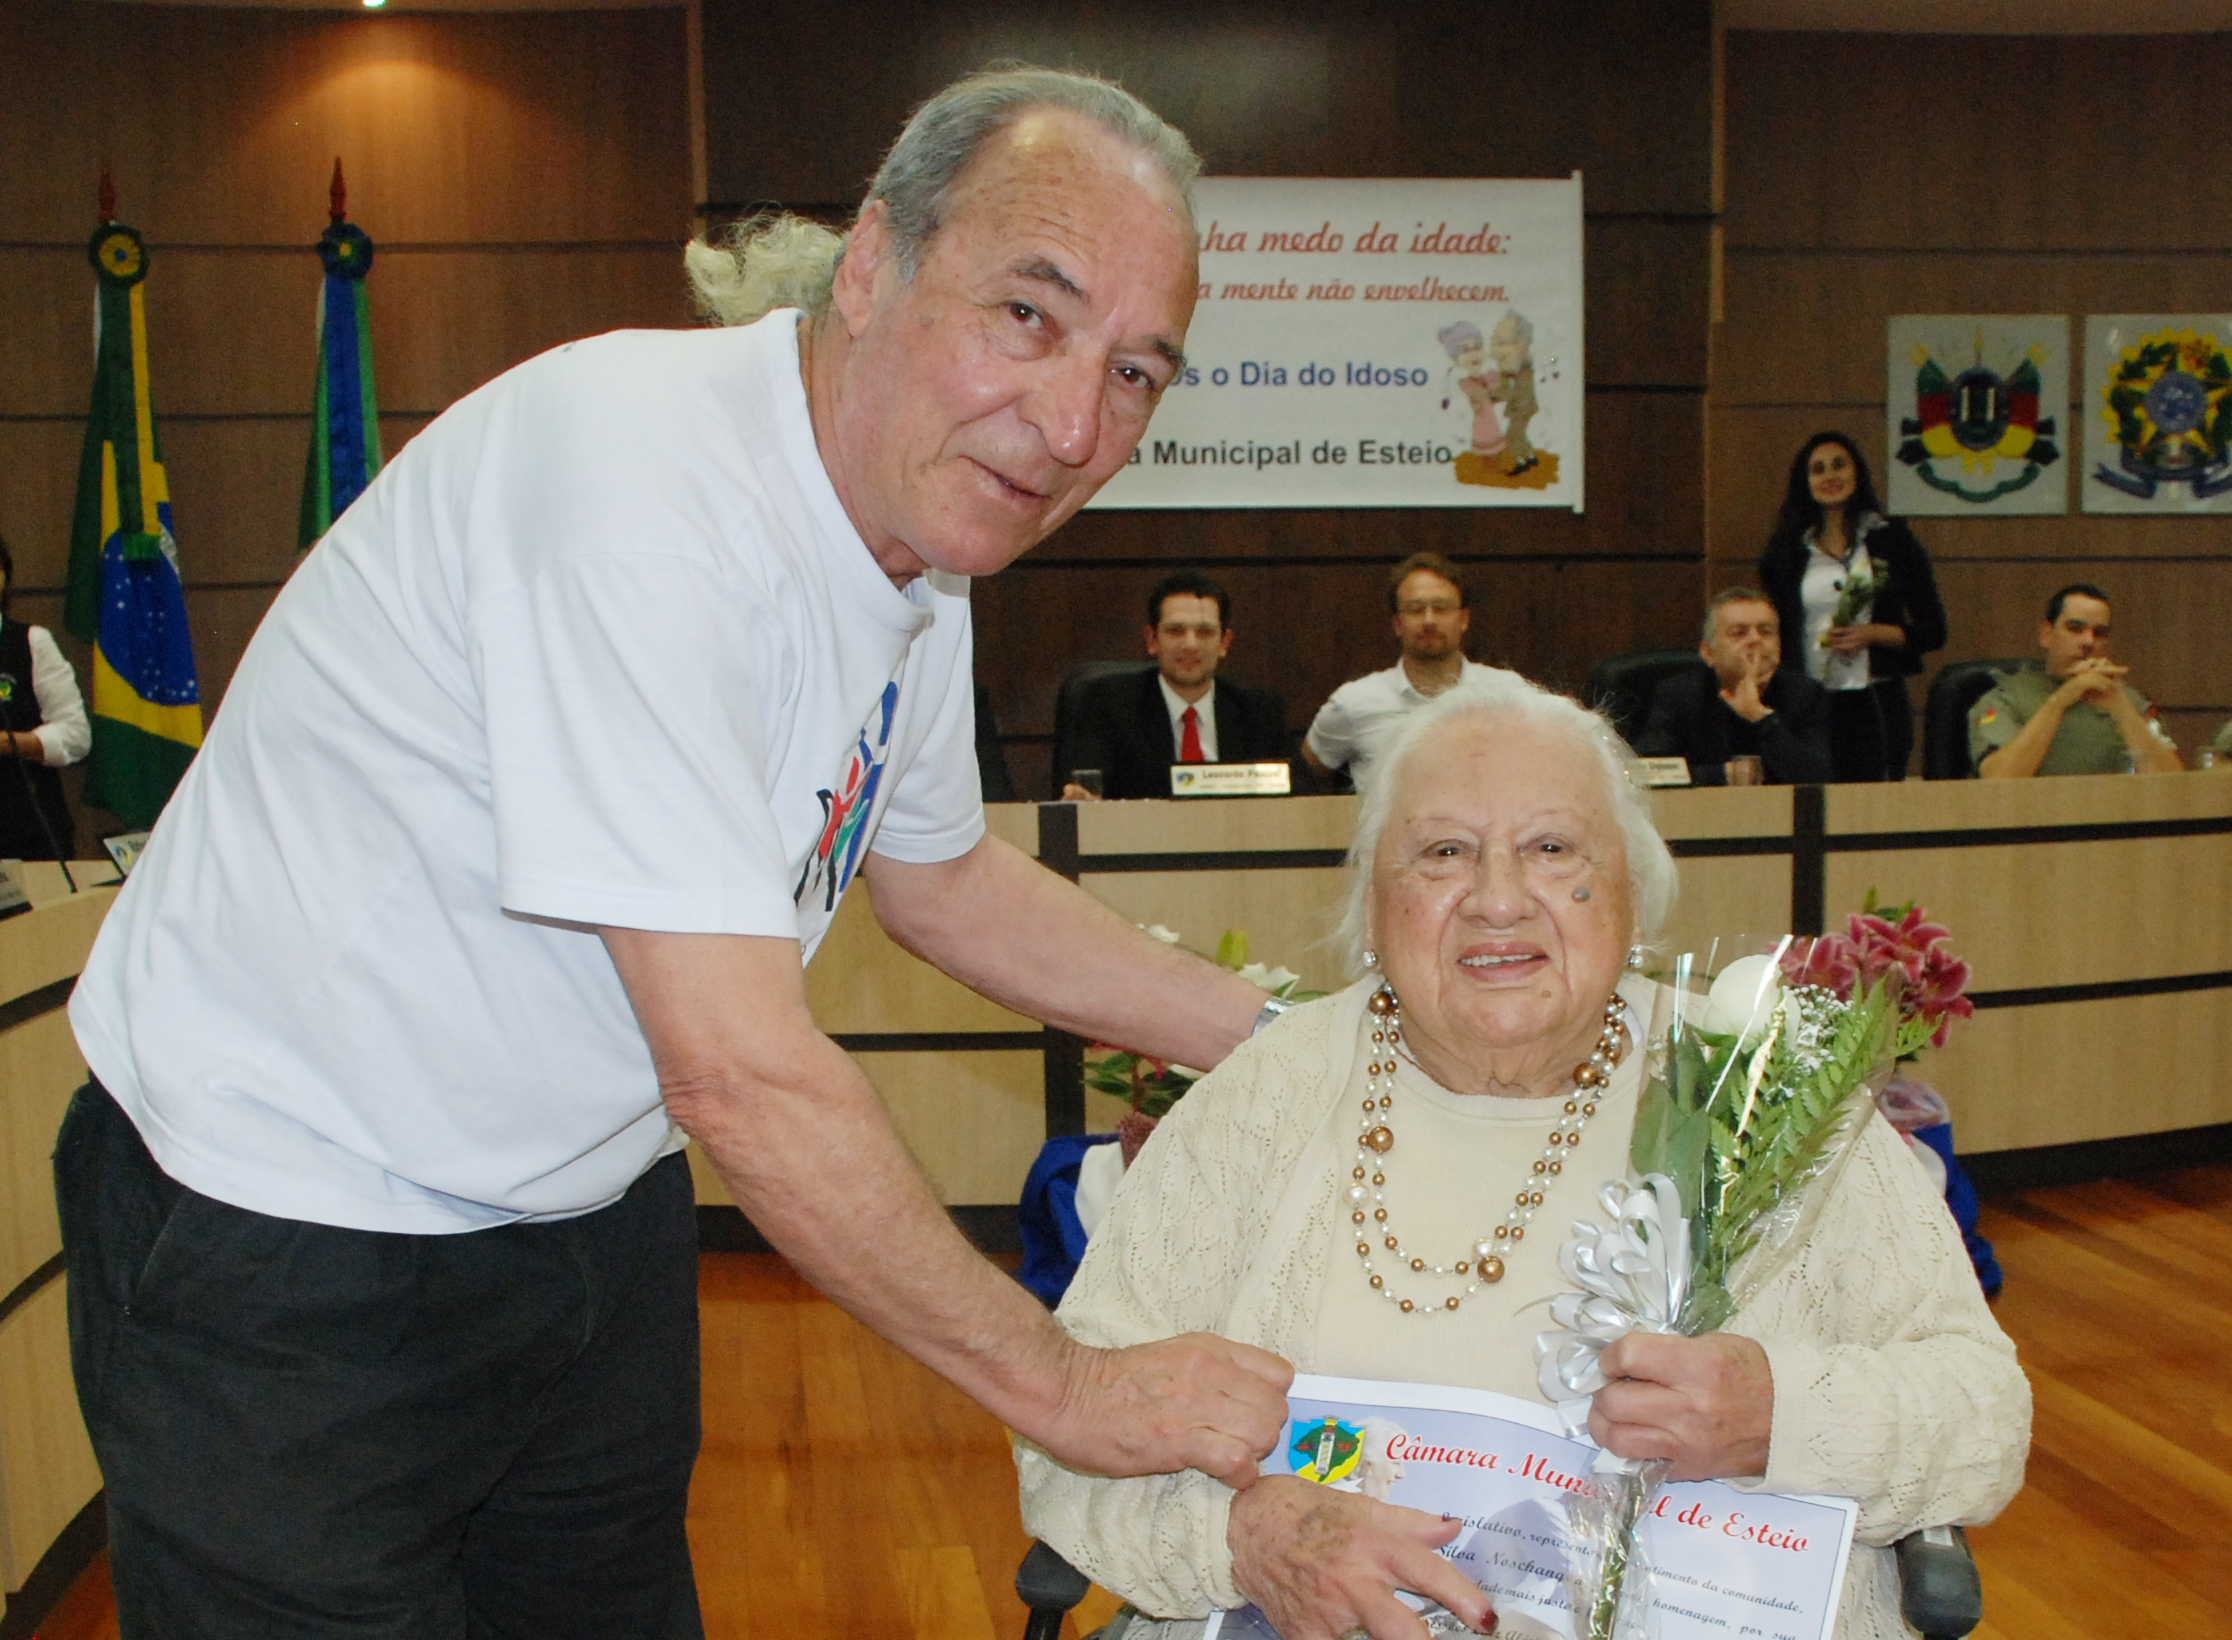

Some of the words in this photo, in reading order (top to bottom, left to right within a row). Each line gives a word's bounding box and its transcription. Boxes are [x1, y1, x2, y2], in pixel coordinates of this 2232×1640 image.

[1257, 220, 1345, 253] medo
[1353, 221, 1399, 253] da
[1408, 221, 1511, 254] idade:
[1220, 277, 1299, 301] mente
[1307, 278, 1356, 301] não
[1364, 275, 1509, 302] envelhecem.
[1212, 367, 1229, 386] o
[1241, 361, 1287, 386] Dia
[1299, 361, 1335, 386] do
[1346, 361, 1428, 386] Idoso
[1153, 439, 1300, 471] Municipal
[1312, 439, 1347, 464] de
[1359, 439, 1452, 464] Esteio
[1386, 1433, 1499, 1470] Câmara
[1677, 1502, 1713, 1530] de
[1722, 1512, 1810, 1552] Esteio
[1504, 1588, 1536, 1602] mais
[1702, 1579, 1719, 1593] da
[1722, 1587, 1803, 1614] comunidade,
[1652, 1598, 1731, 1630] homenagem,
[1739, 1625, 1763, 1637] por
